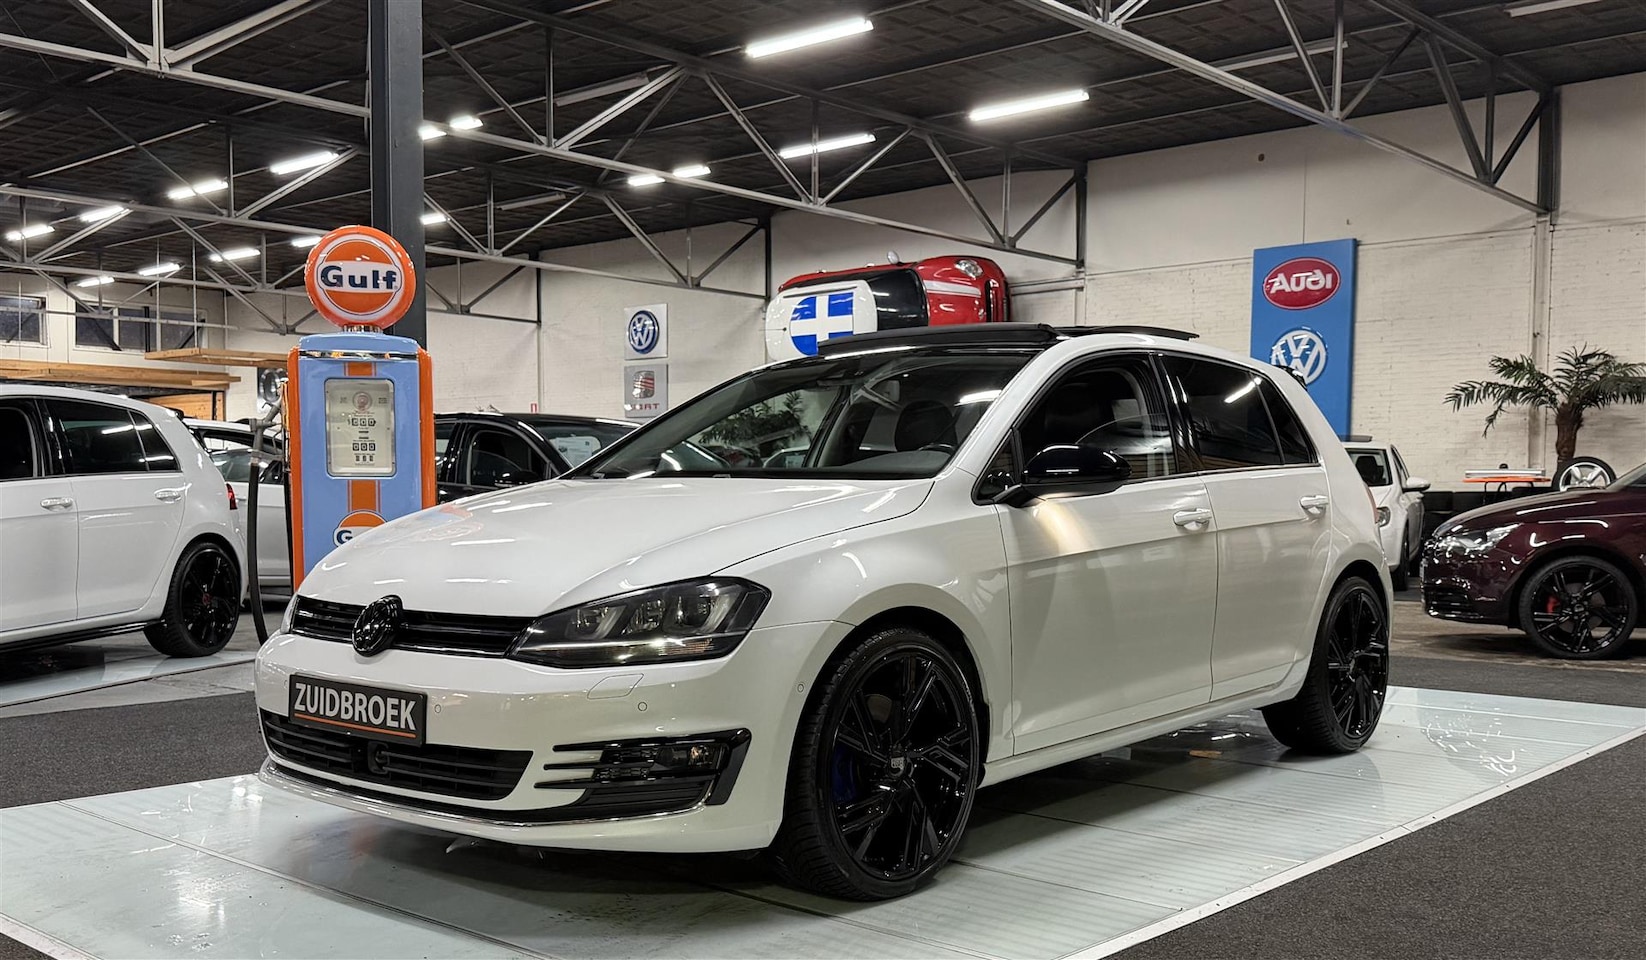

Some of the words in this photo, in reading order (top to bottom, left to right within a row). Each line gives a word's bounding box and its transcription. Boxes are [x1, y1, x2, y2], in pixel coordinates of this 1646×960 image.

[320, 265, 397, 290] Gulf
[629, 402, 660, 411] AT
[336, 529, 353, 544] G
[294, 682, 416, 731] ZUIDBROEK
